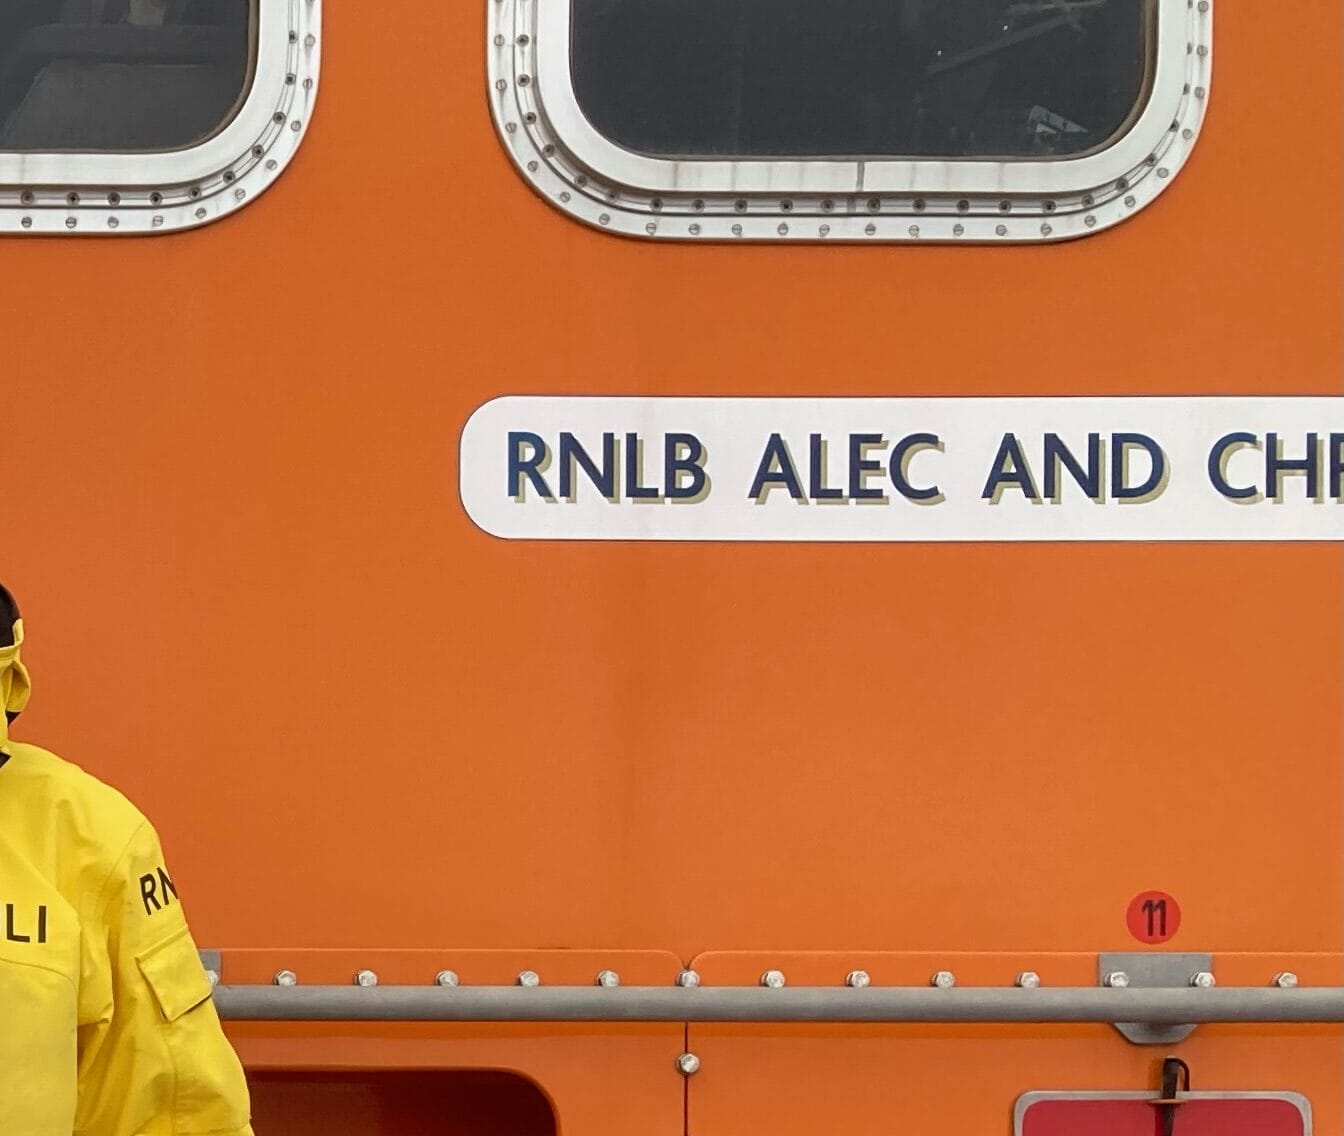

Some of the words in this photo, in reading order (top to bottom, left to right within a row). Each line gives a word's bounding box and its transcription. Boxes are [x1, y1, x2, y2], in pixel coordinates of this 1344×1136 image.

[507, 431, 712, 504] RNLB
[748, 432, 946, 505] ALEC
[981, 432, 1171, 505] AND
[1141, 899, 1167, 937] 11
